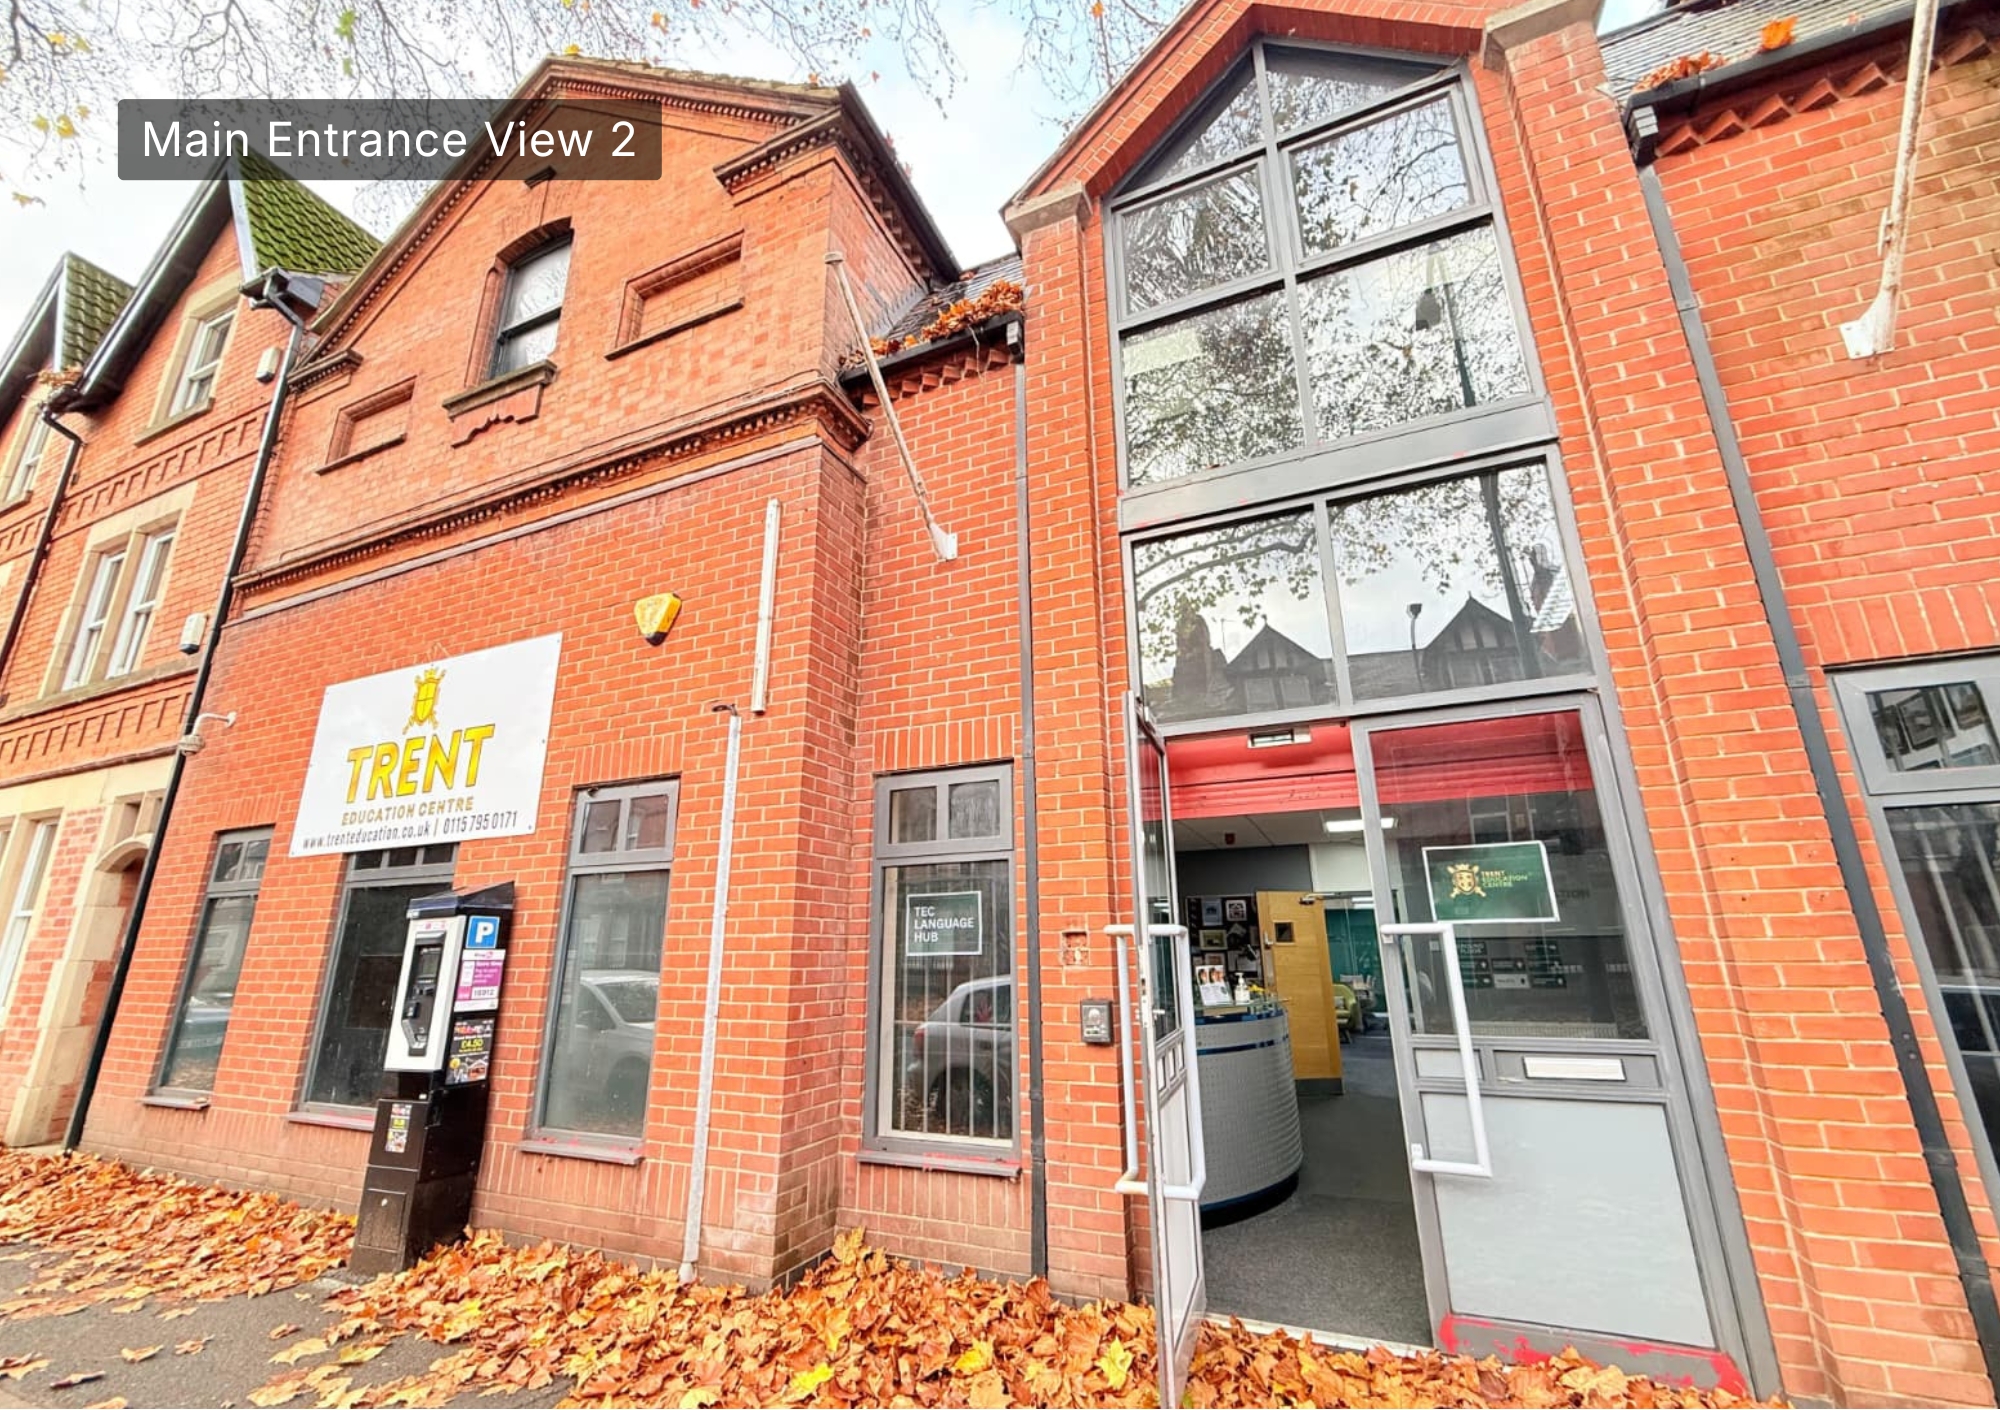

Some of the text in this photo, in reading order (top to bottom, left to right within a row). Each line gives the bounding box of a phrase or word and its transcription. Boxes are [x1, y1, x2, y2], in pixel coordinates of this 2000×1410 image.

[346, 723, 496, 804] TRENT
[341, 796, 474, 826] EDUCATION CENTRE
[303, 820, 431, 849] www.trenteducation.co.uk
[914, 906, 935, 917] TEC
[475, 921, 494, 943] P
[914, 917, 974, 930] LANGUAGE
[914, 931, 938, 943] HUB
